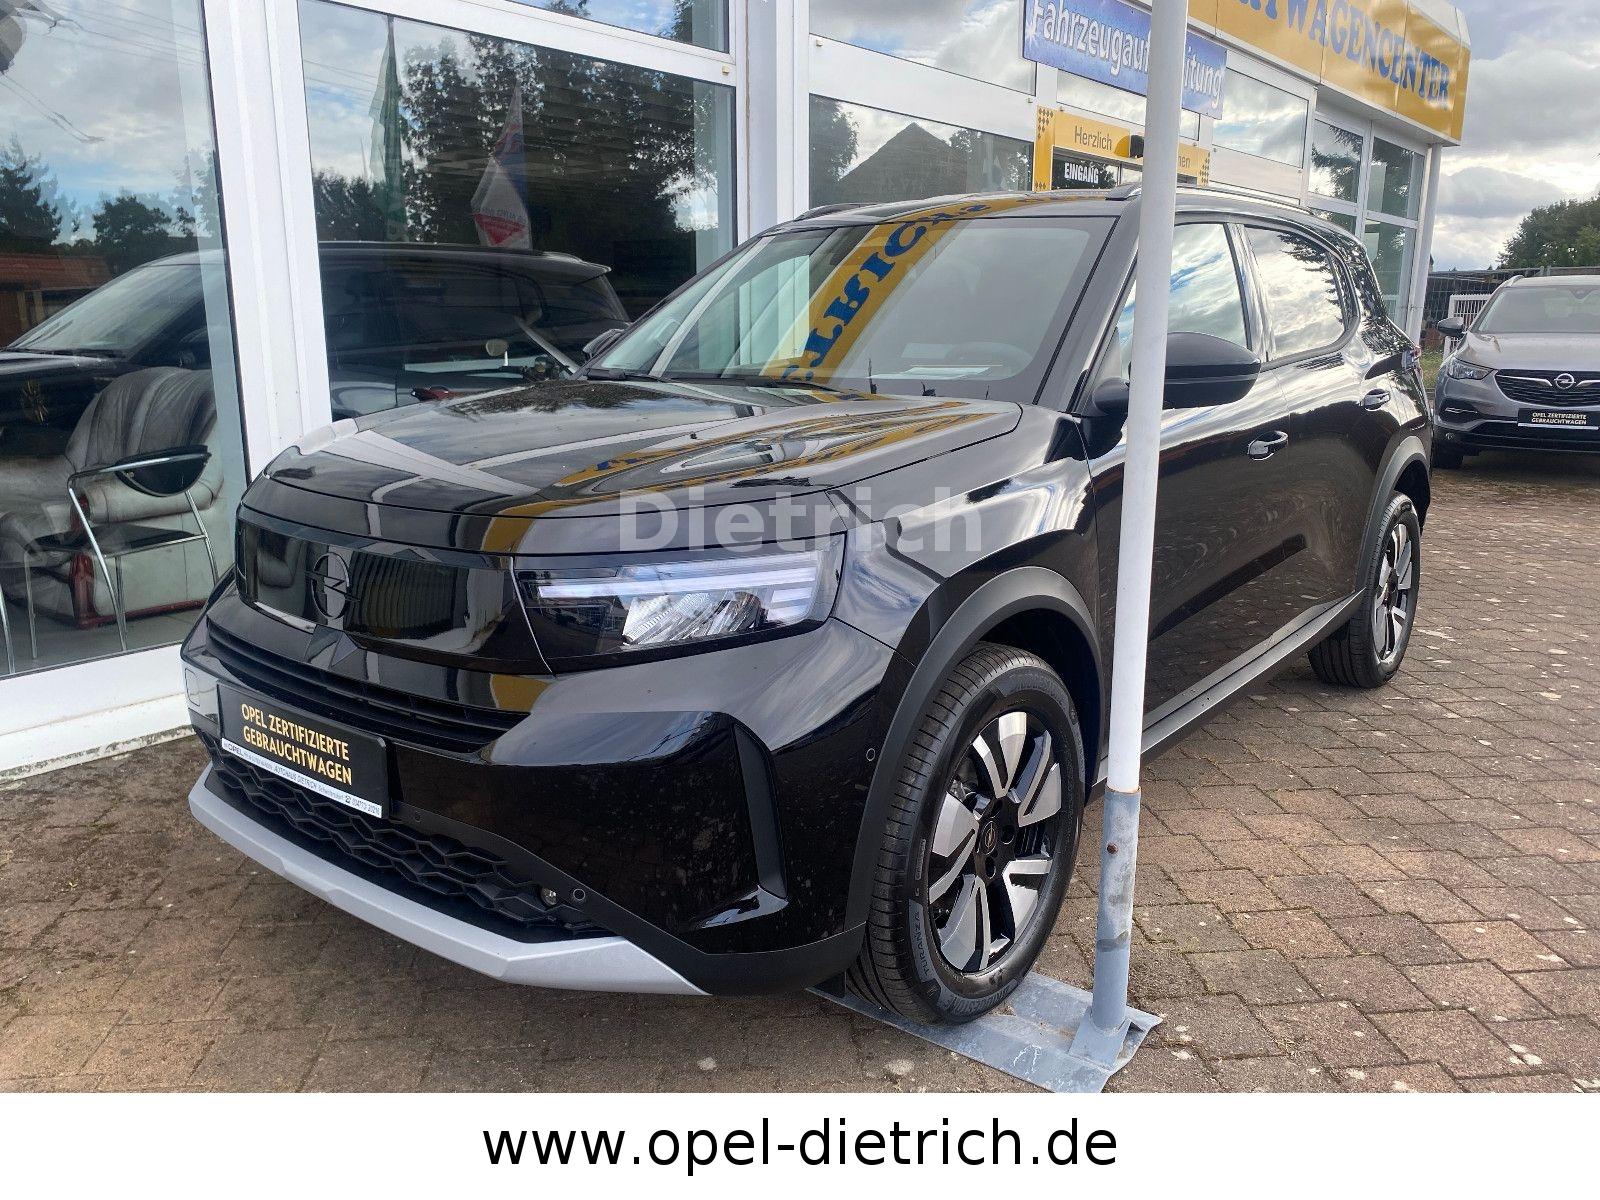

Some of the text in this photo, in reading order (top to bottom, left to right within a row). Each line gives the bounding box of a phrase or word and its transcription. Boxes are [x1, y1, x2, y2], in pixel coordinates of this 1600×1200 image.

[1074, 125, 1112, 151] Herzlich
[1064, 161, 1099, 184] EINGANG
[1532, 417, 1587, 425] GEBRAUCHTWAGEN
[1548, 412, 1587, 420] ZERTIFIZIERTE
[241, 703, 268, 729] OPEL
[268, 714, 350, 761] ZERTIFIZIERTE
[243, 725, 352, 786] GEBRAUCHTWAGEN
